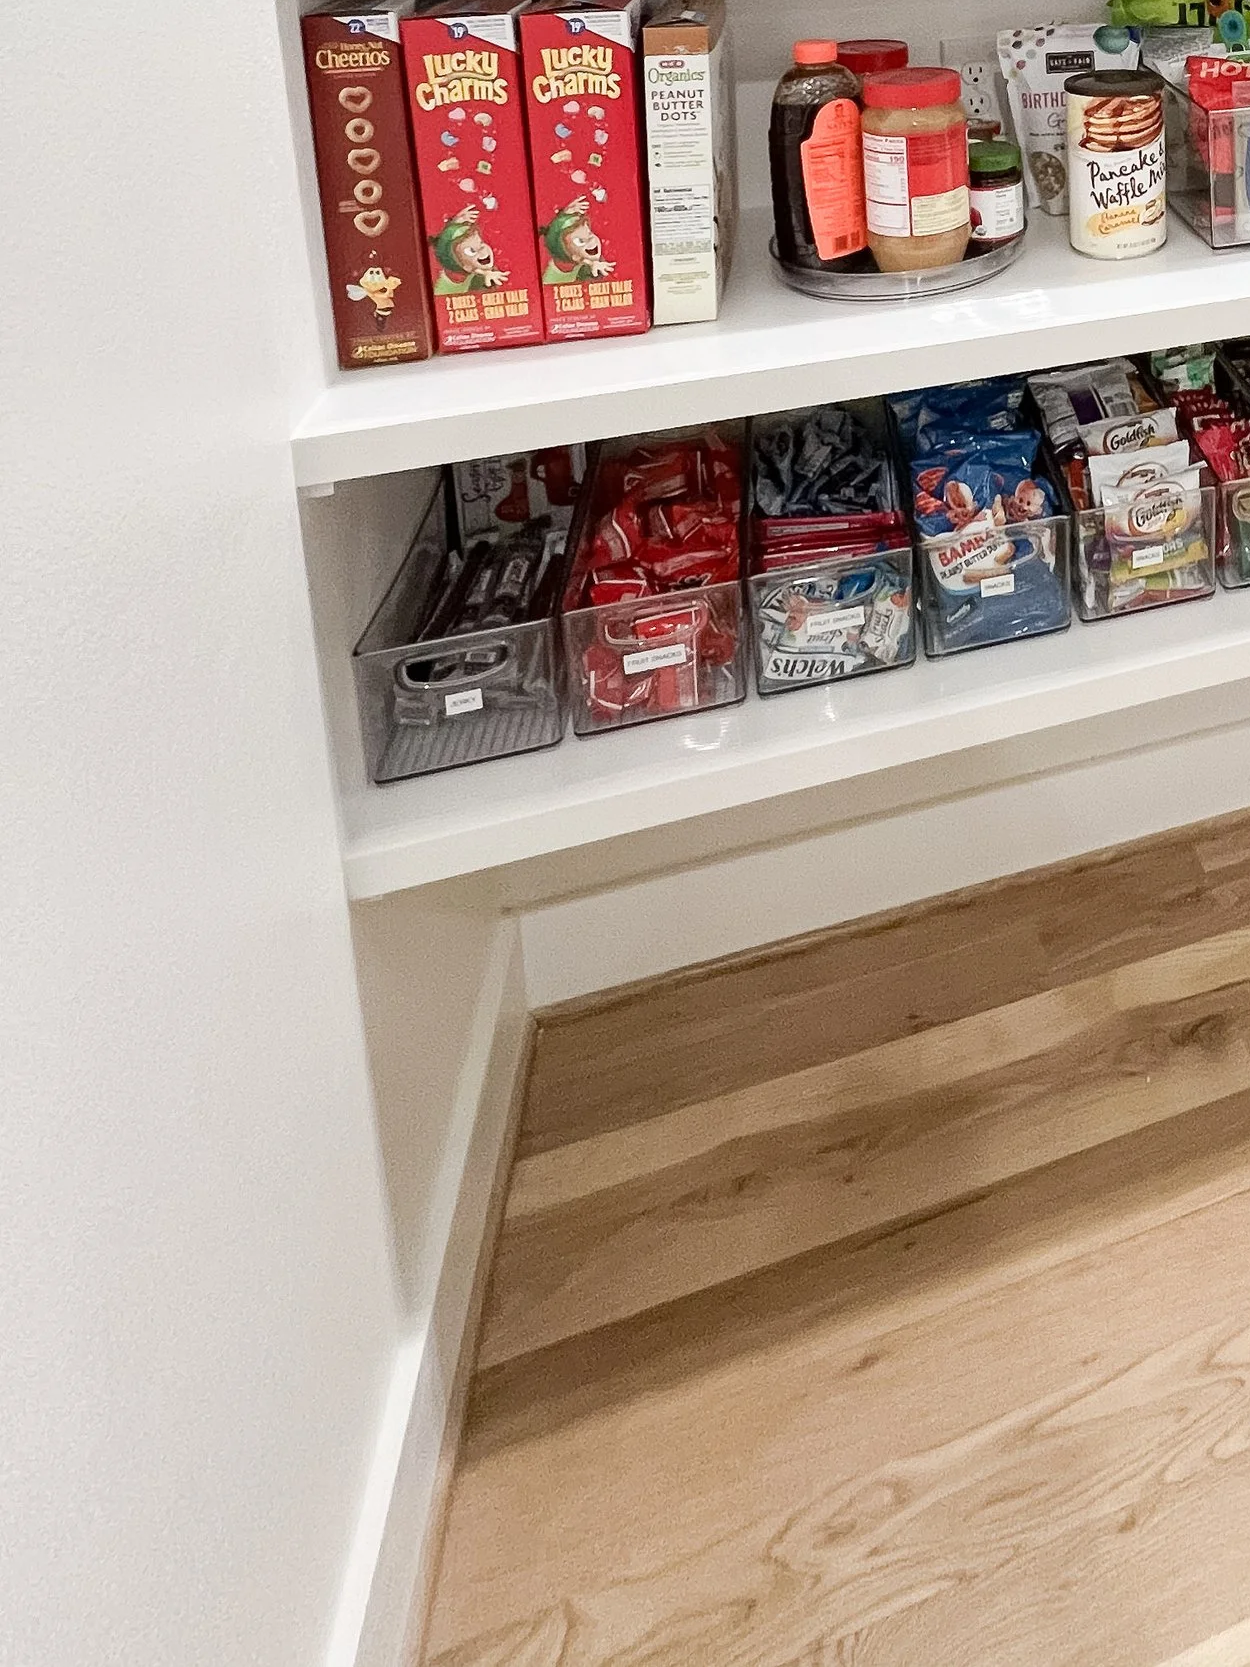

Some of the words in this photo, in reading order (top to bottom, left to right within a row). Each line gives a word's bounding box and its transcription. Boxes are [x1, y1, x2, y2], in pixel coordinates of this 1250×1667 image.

[452, 27, 463, 39] 19
[569, 20, 583, 33] 19
[315, 50, 391, 70] Cheerios
[422, 49, 499, 85] Lucky
[540, 44, 614, 79] Lucky
[648, 67, 706, 86] Organics
[415, 78, 510, 111] Charms
[532, 71, 621, 104] Charms
[651, 89, 705, 101] PEANUT
[652, 100, 705, 112] BUTTER
[660, 111, 698, 122] DOTS
[1086, 148, 1158, 189] Pancake
[1090, 176, 1148, 210] Waffle
[1110, 423, 1156, 451] Goldfish
[770, 657, 846, 678] Welch's
